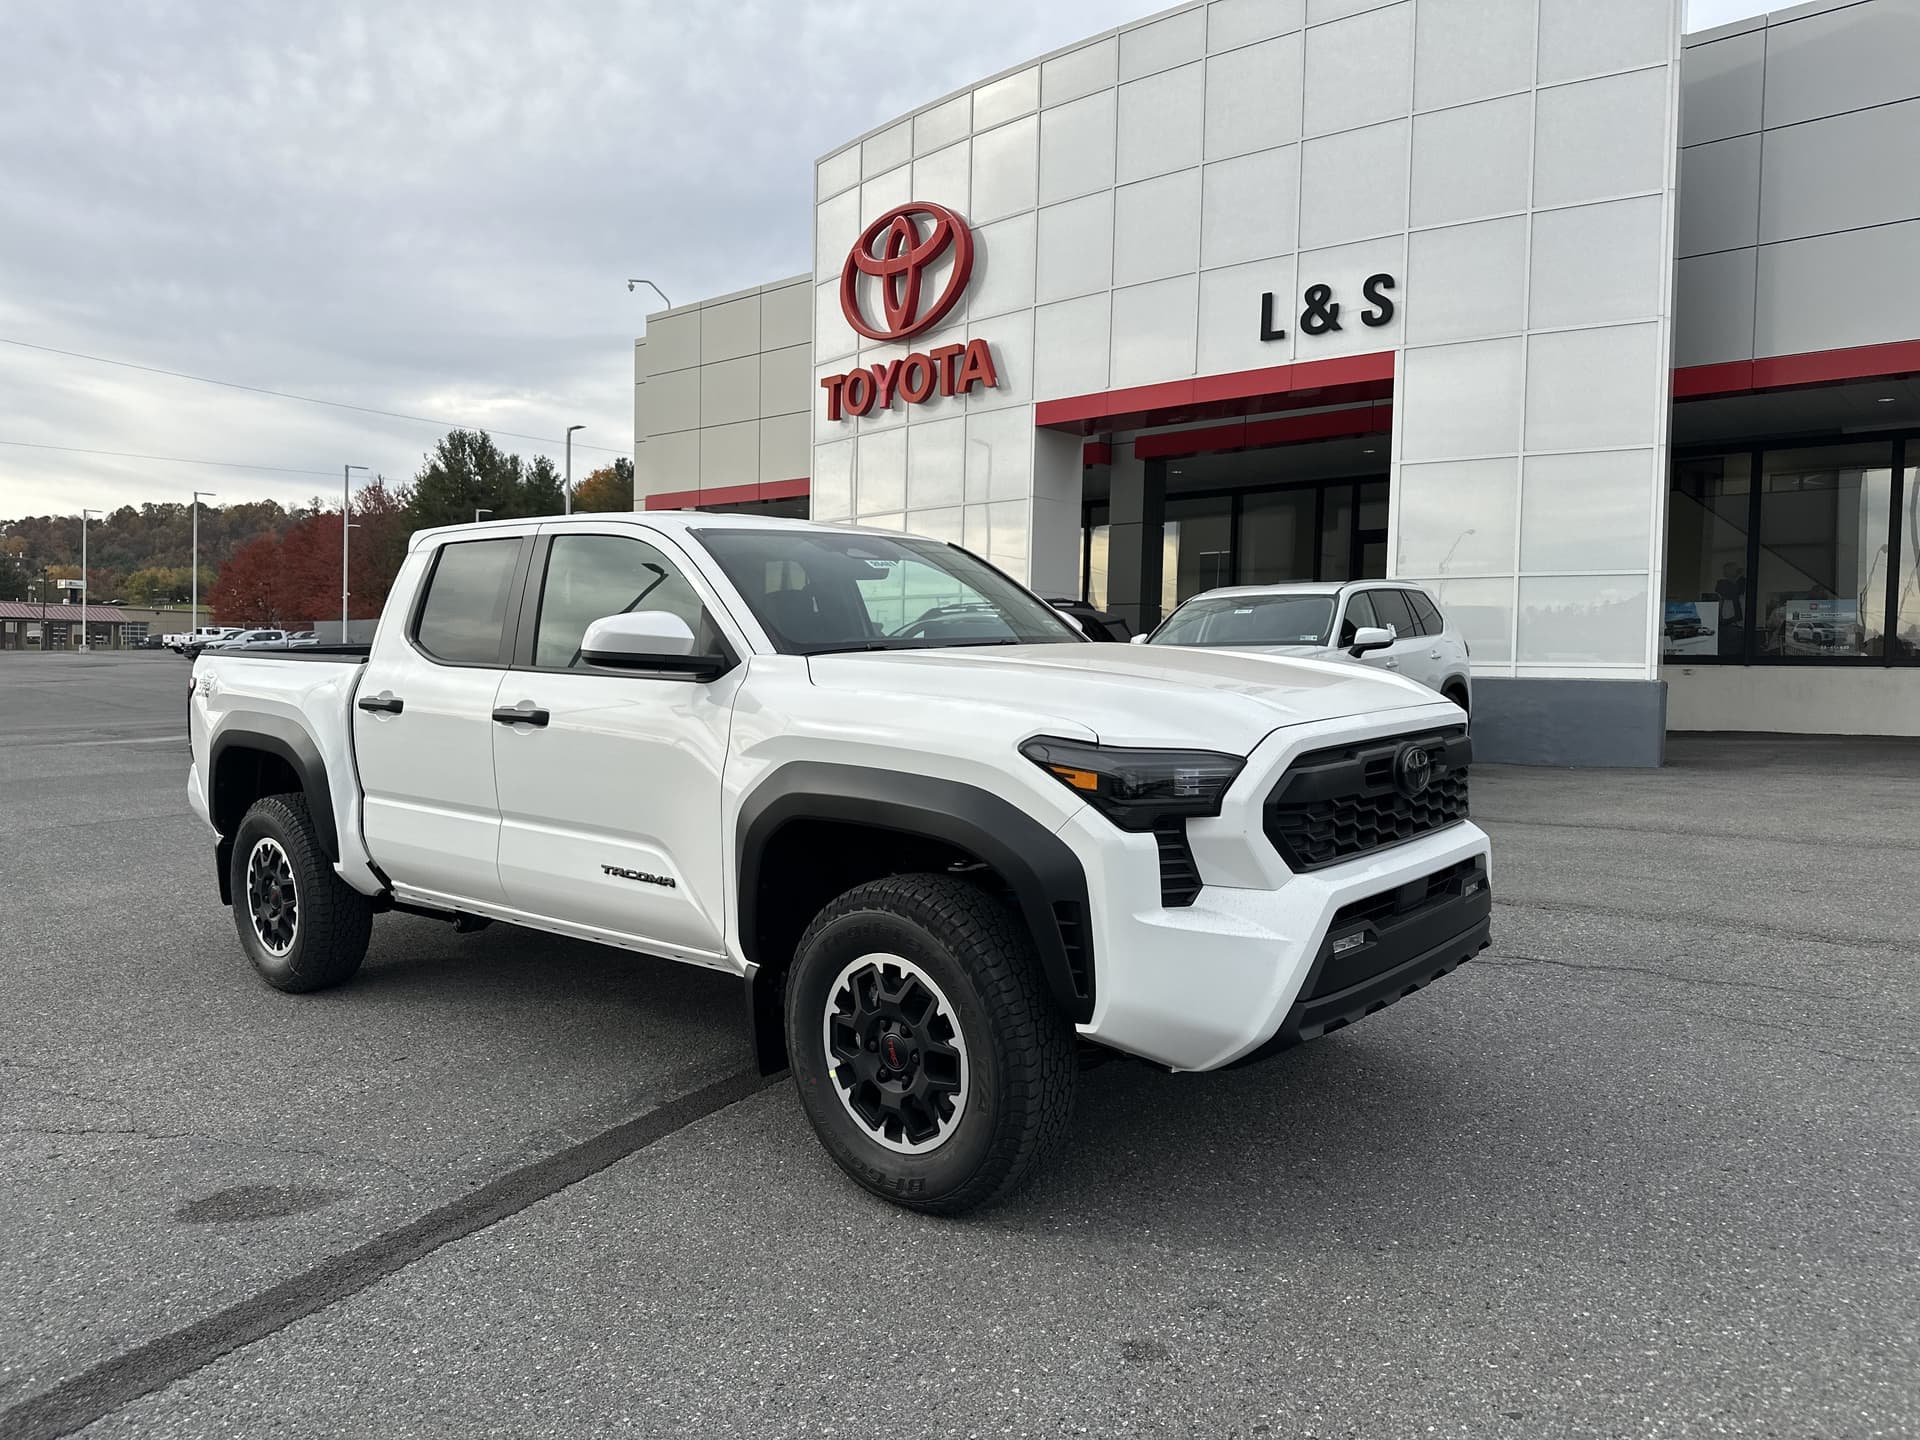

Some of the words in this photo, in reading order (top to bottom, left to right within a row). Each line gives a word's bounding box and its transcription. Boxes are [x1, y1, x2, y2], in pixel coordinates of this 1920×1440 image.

[1260, 291, 1286, 342] L
[1300, 283, 1343, 336] &
[1360, 272, 1396, 328] S
[820, 338, 998, 422] TOYOTA
[600, 863, 677, 889] TACOMA
